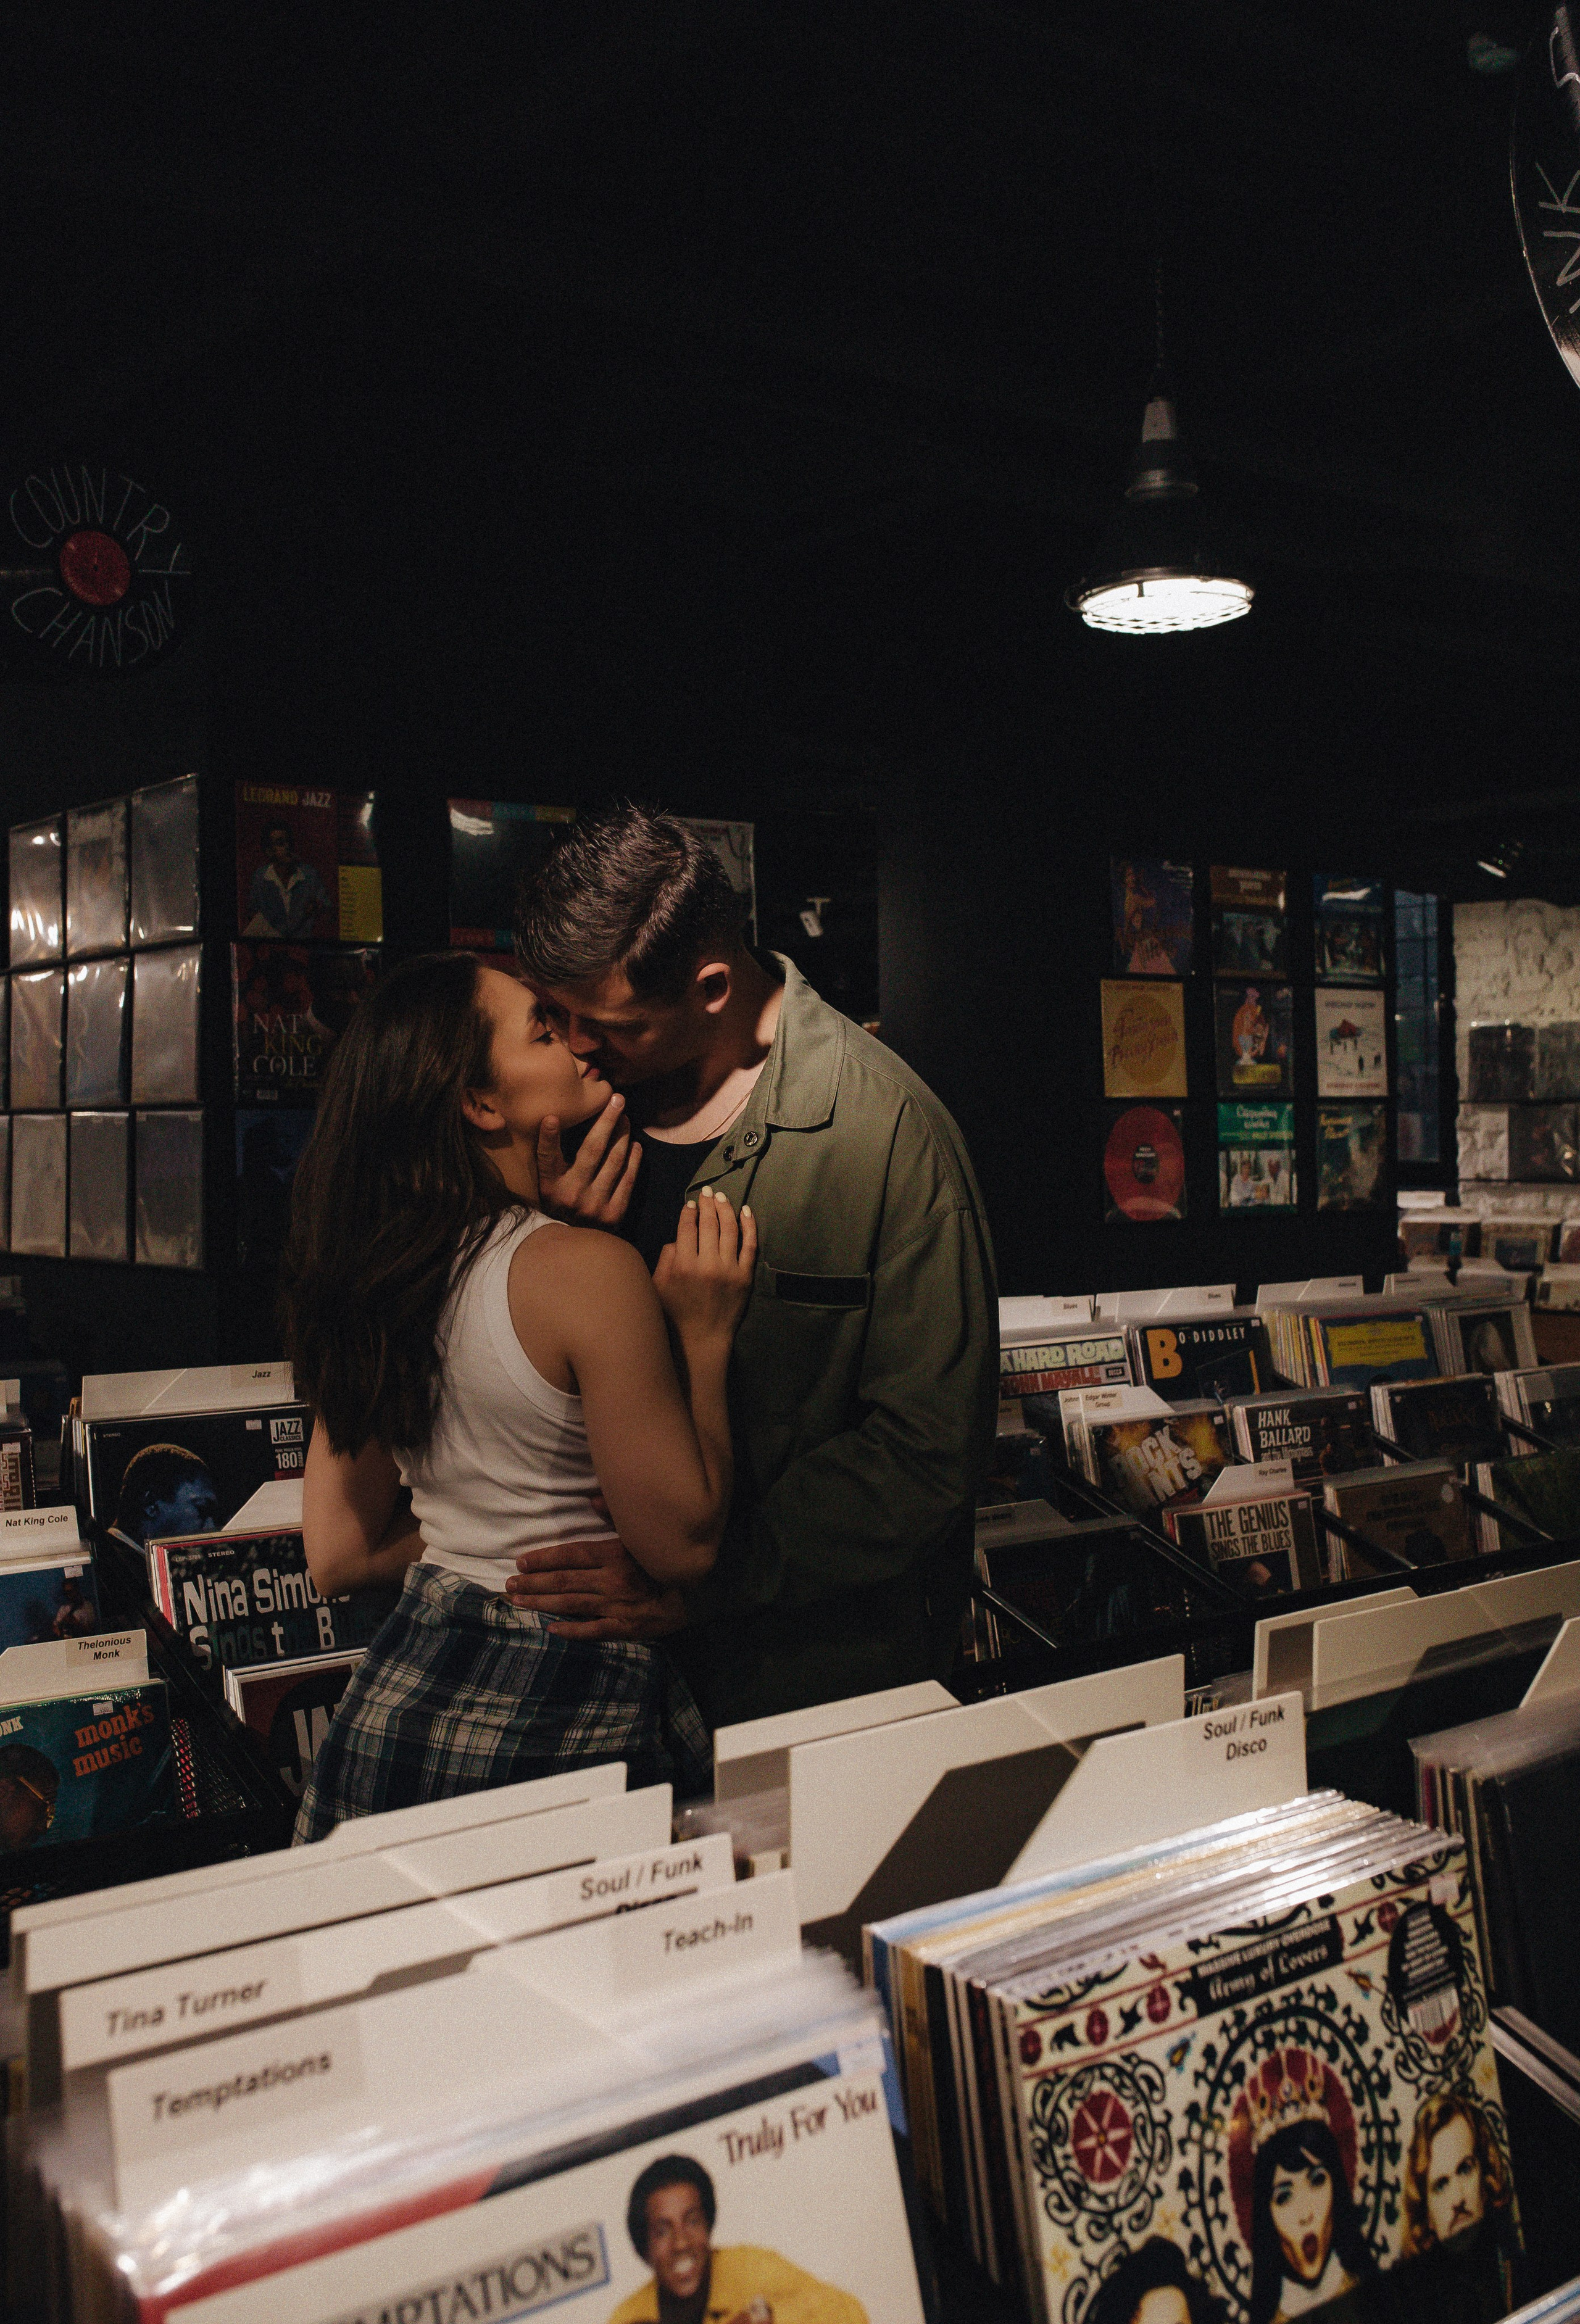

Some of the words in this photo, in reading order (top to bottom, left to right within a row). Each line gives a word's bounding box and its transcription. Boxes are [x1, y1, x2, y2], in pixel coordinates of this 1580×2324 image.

[9, 463, 191, 575] COUNTRY
[12, 579, 175, 668] CHANSON
[301, 791, 331, 808] JAZZ
[254, 1013, 302, 1034] NAT
[264, 1032, 323, 1055] KING
[253, 1055, 317, 1077] COLE
[1193, 1327, 1245, 1343] DIDDLEY
[1012, 1345, 1068, 1371] HARD
[1066, 1339, 1126, 1367] ROAD
[252, 1369, 271, 1379] Jazz
[273, 1420, 301, 1442] JAZZ
[1258, 1409, 1292, 1429] HANK
[1259, 1426, 1311, 1448] BALLARD
[275, 1451, 297, 1469] 180
[6, 1519, 21, 1527] Nat
[24, 1517, 45, 1526] King
[48, 1514, 68, 1524] Cole
[1206, 1508, 1236, 1540] THE
[1238, 1500, 1289, 1535] GENIUS
[207, 1550, 235, 1558] STEREO
[1210, 1538, 1241, 1561] SINGS
[1241, 1535, 1260, 1556] THE
[1261, 1529, 1292, 1552] BLUES
[183, 1573, 249, 1626] Nina
[252, 1567, 350, 1614] Simo
[78, 1637, 131, 1651] Thelonious
[93, 1650, 120, 1660] Monk
[74, 1702, 155, 1749] monk's
[1204, 1716, 1237, 1740] Soul
[1250, 1704, 1284, 1729] Funk
[72, 1735, 144, 1778] music
[1226, 1738, 1267, 1761] Disco
[580, 1869, 631, 1901] Soul
[651, 1852, 702, 1885] Funk
[663, 1914, 754, 1954] Teach-In
[1259, 1953, 1276, 1985] of
[1278, 1944, 1329, 1975] Lovers
[106, 2004, 165, 2036] Tina
[177, 1979, 266, 2018] Turner
[151, 2051, 332, 2123] Temptations
[717, 2114, 785, 2168] Truly
[790, 2104, 828, 2141] For
[834, 2088, 877, 2124] You
